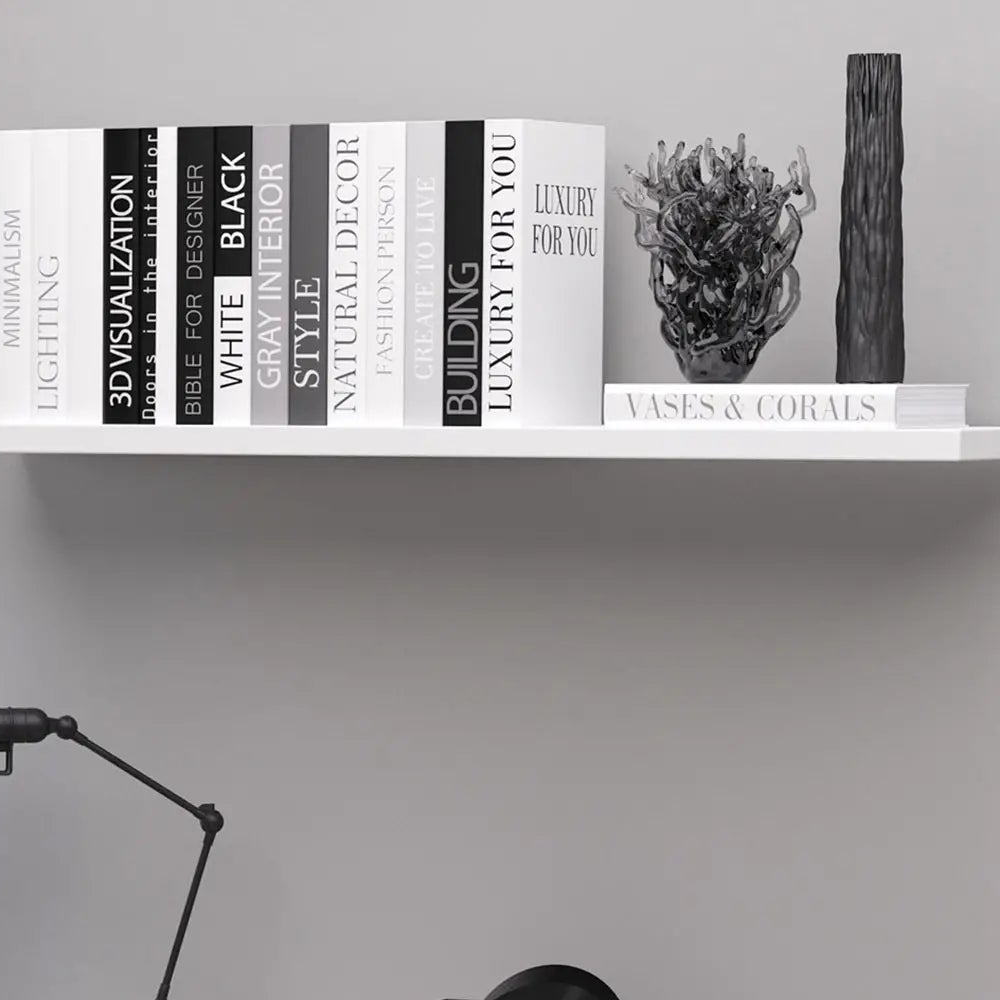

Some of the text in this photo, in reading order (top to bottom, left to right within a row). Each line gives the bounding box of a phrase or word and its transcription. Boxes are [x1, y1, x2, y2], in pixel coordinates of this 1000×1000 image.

[3, 208, 21, 347] MINIMALISM
[110, 174, 134, 407] 3D VISUALIZATION
[142, 134, 157, 420] Doors in the interior
[185, 164, 203, 415] BIBLE FOR DESIGNER
[220, 152, 246, 389] WHITE BLACK
[257, 163, 283, 389] GRAY INTERIOR
[334, 136, 360, 413] NATURAL DECOR
[376, 165, 396, 376] FASHION PERSON
[413, 176, 436, 380] CREATE TO LIVE
[488, 132, 517, 413] LUXURY FOR YOU
[532, 224, 598, 257] FOR YOU
[534, 183, 597, 217] LUXURY
[37, 255, 60, 411] LIGHTING
[293, 277, 321, 388] STYLE
[446, 262, 480, 416] BUILDING
[625, 392, 877, 422] VASES & CORALS
